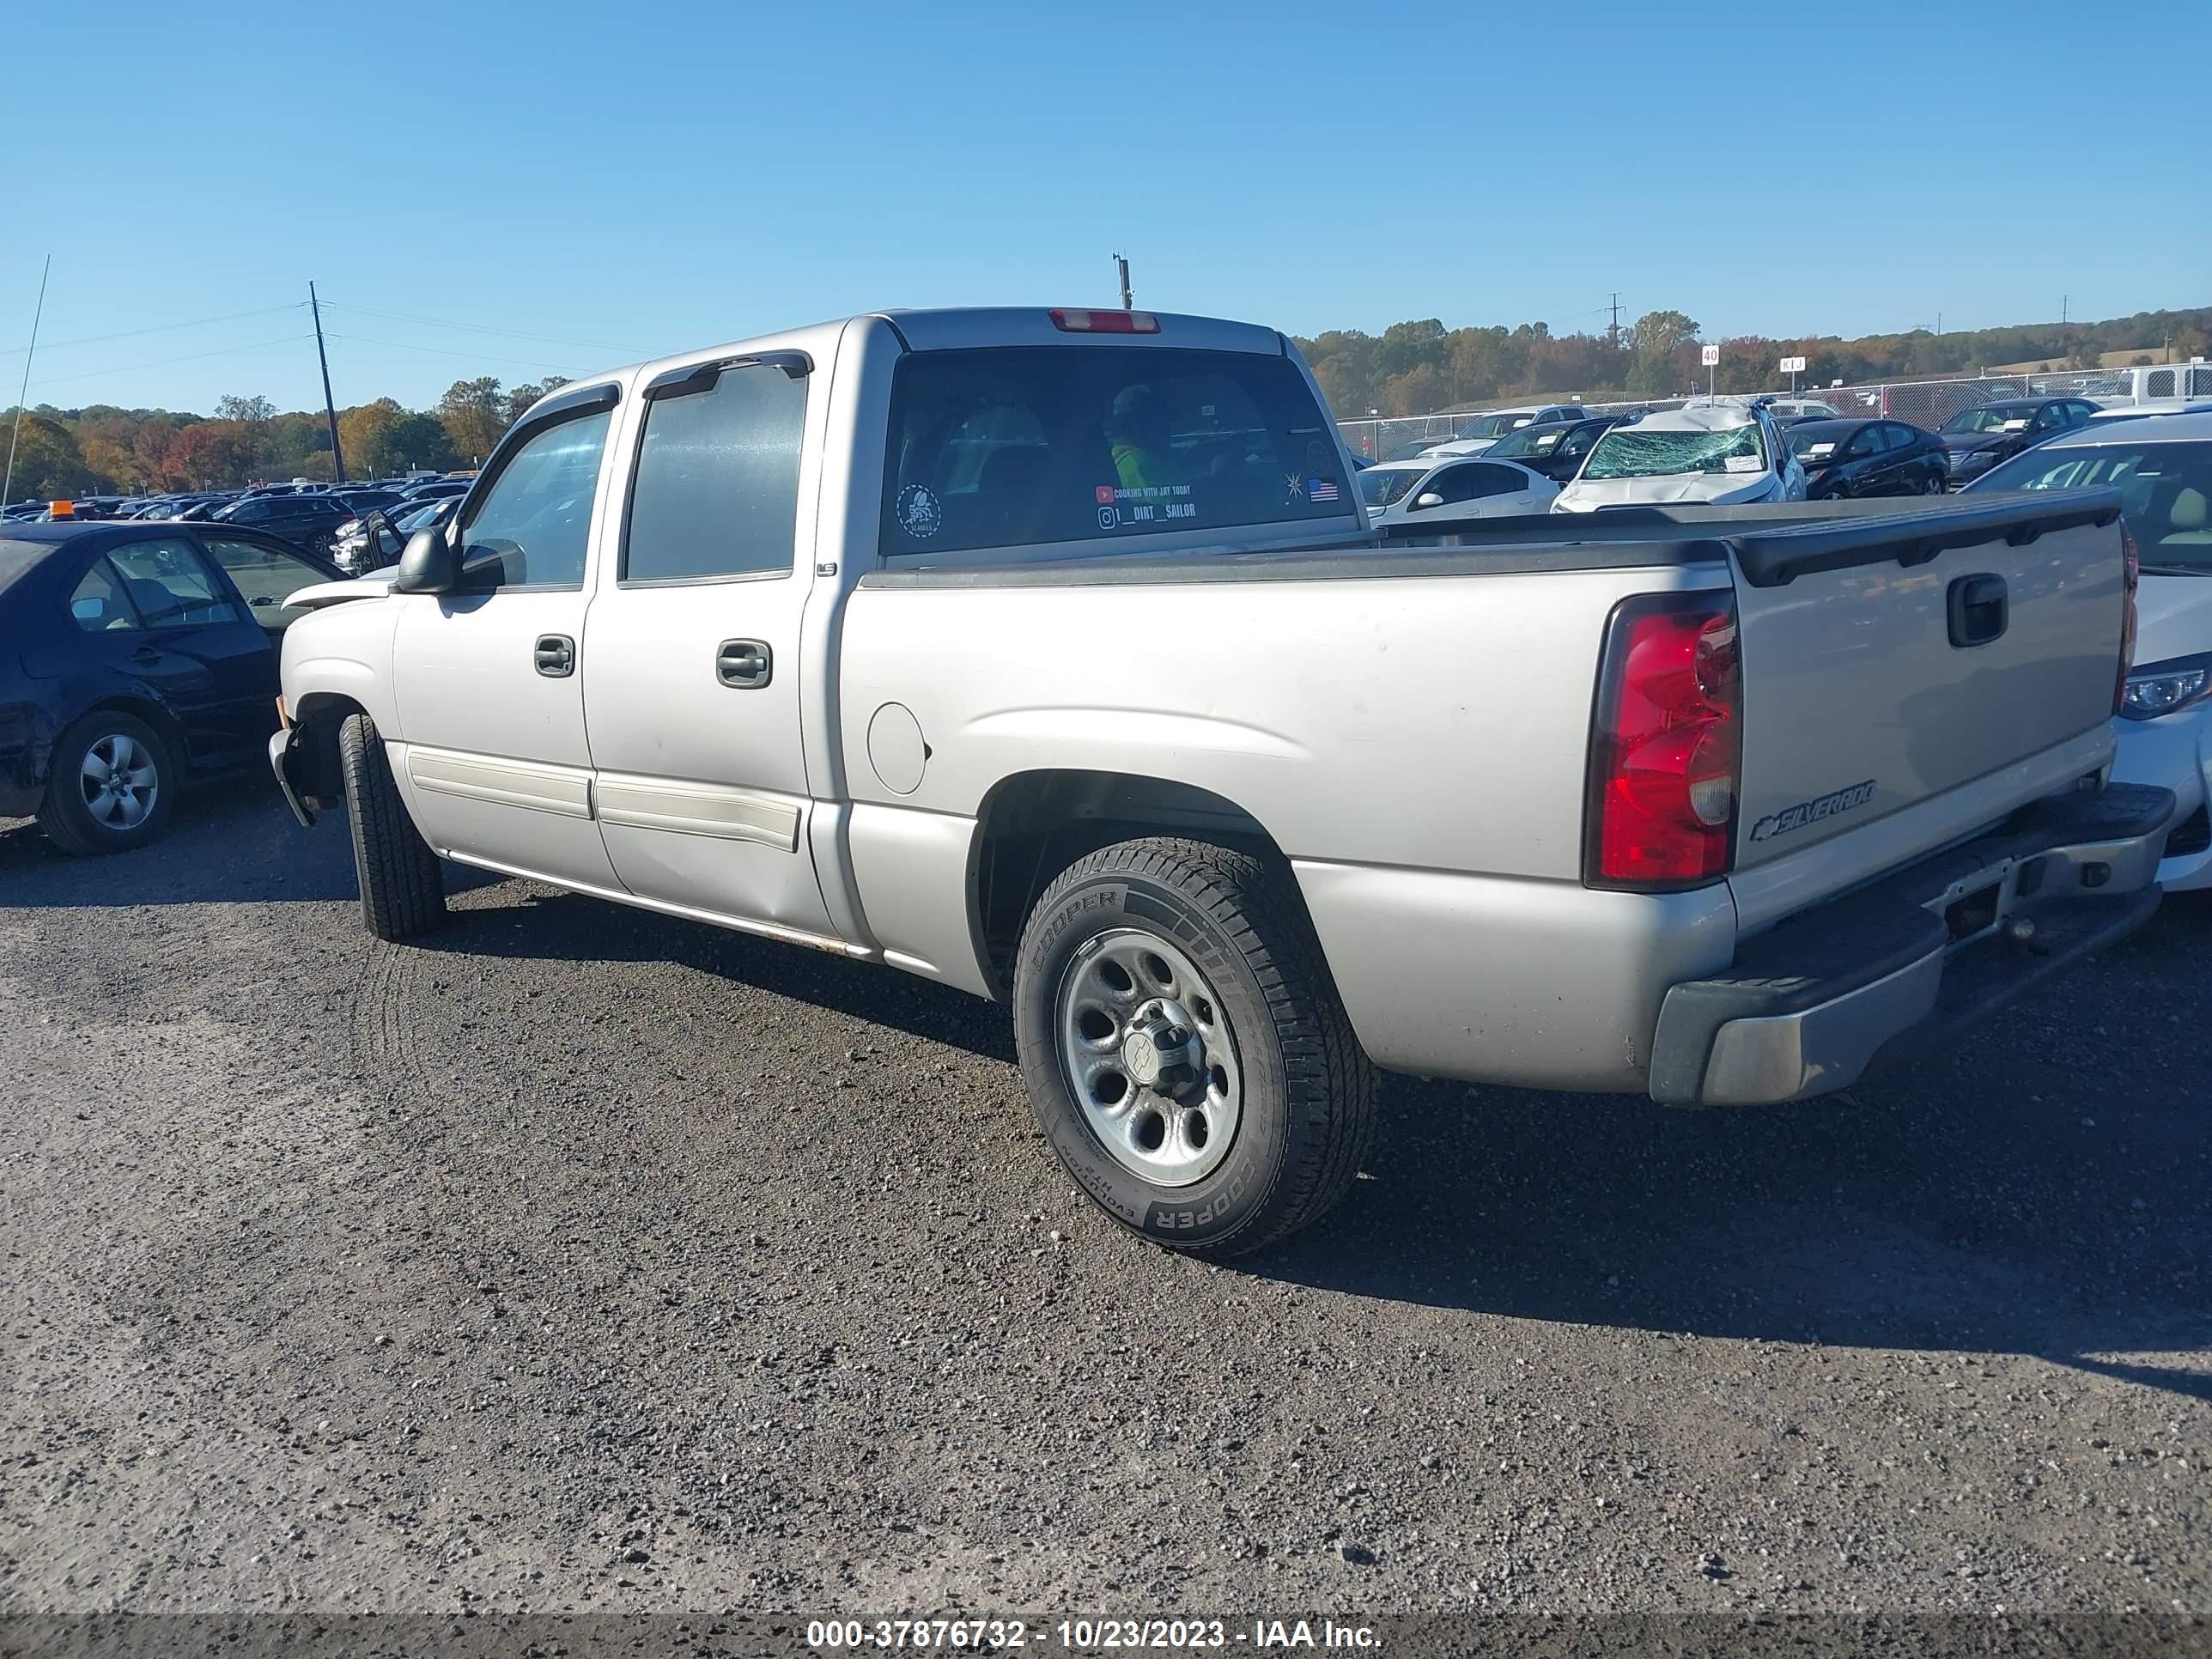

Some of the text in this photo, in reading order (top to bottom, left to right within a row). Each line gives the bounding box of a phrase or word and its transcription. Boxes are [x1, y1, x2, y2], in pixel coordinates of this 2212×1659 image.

[1704, 349, 1717, 361] 40
[1114, 484, 1191, 499] COOKING WITH JAY TODAY
[817, 562, 837, 577] LS
[1777, 779, 1876, 836] SILVERADO
[1031, 891, 1117, 972] COOPER
[1061, 1145, 1135, 1218] EVOLUTION
[1085, 1165, 1113, 1192] HT2
[1156, 1157, 1256, 1229] COOPER
